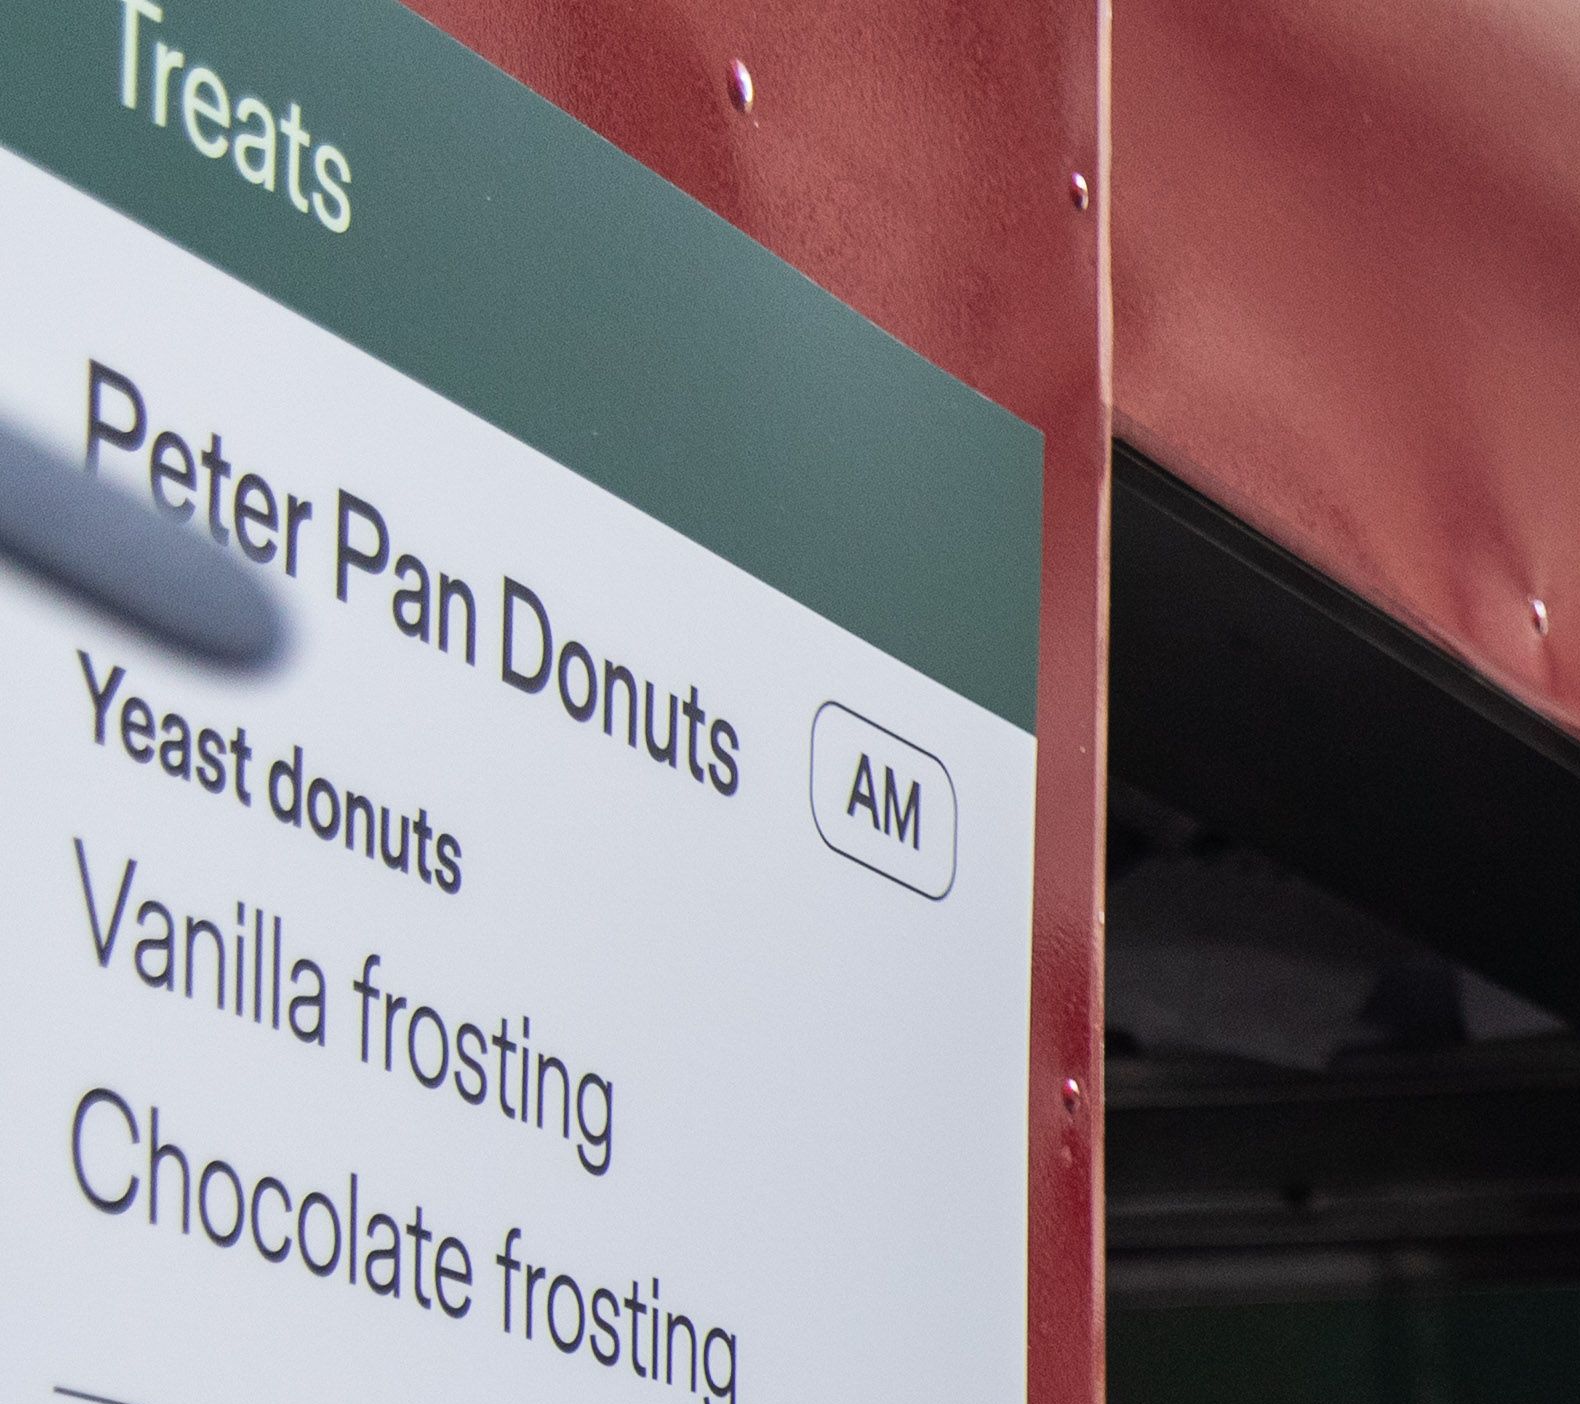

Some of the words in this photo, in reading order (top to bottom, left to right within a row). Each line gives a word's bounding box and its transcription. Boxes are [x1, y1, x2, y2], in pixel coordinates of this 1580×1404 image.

[119, 0, 352, 234] Treats
[84, 357, 314, 580] Peter
[335, 487, 478, 668] Pan
[500, 573, 741, 798] Donuts
[75, 648, 254, 809] Yeast
[267, 743, 463, 896] donuts
[845, 751, 922, 852] AM
[72, 836, 329, 1048] Vanilla
[351, 952, 615, 1178] frosting
[70, 1086, 474, 1320] Chocolate
